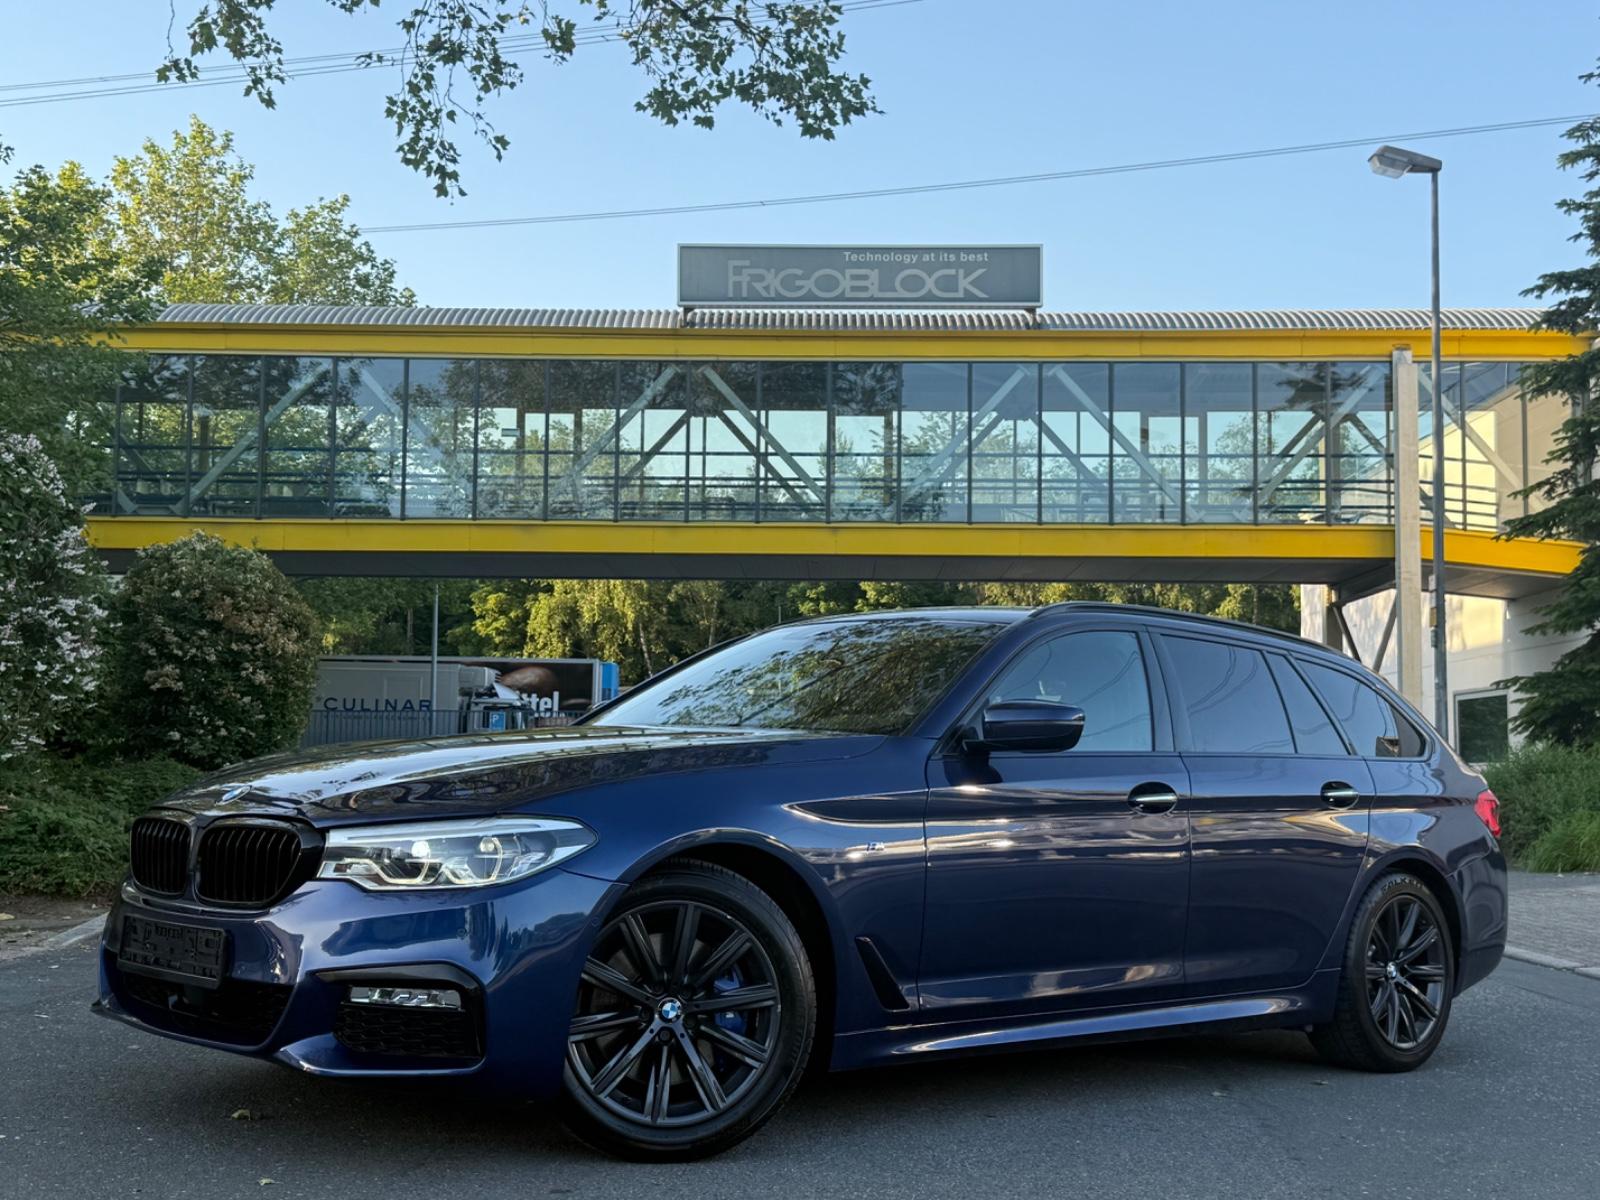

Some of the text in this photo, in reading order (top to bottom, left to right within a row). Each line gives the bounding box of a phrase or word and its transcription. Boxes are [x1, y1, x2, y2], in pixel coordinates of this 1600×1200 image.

[843, 251, 989, 264] Technology at its best
[727, 260, 990, 298] FRIGOBLOCK
[323, 697, 432, 712] CULINAR
